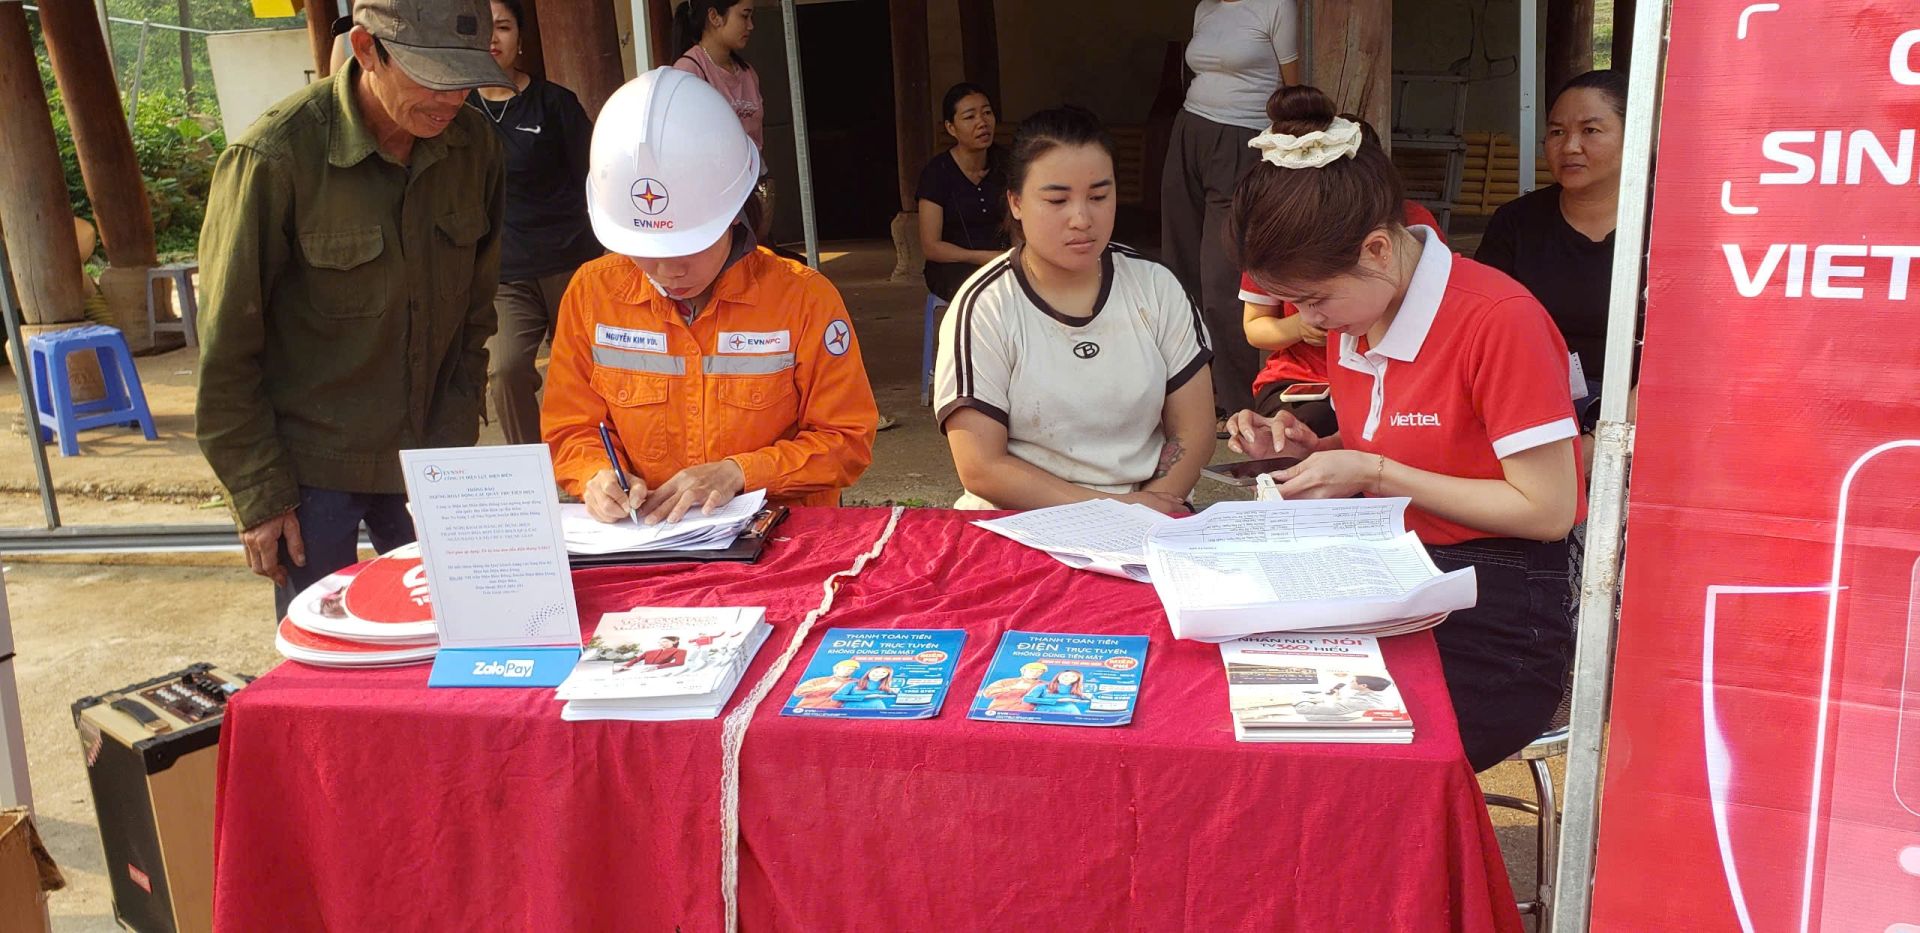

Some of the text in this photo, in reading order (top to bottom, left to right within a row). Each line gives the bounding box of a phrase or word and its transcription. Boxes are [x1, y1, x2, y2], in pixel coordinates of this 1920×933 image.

[1759, 129, 1920, 186] SIN
[633, 218, 674, 229] EVNNPC
[633, 336, 646, 344] KIM
[747, 337, 781, 346] EVNNPC
[832, 639, 875, 648] ĐIỆN
[1066, 637, 1095, 645] TOÁN
[1322, 637, 1363, 646] NÓI
[1017, 641, 1059, 652] ĐIỆN
[1261, 643, 1310, 651] TV360
[472, 660, 534, 678] ZaloPay
